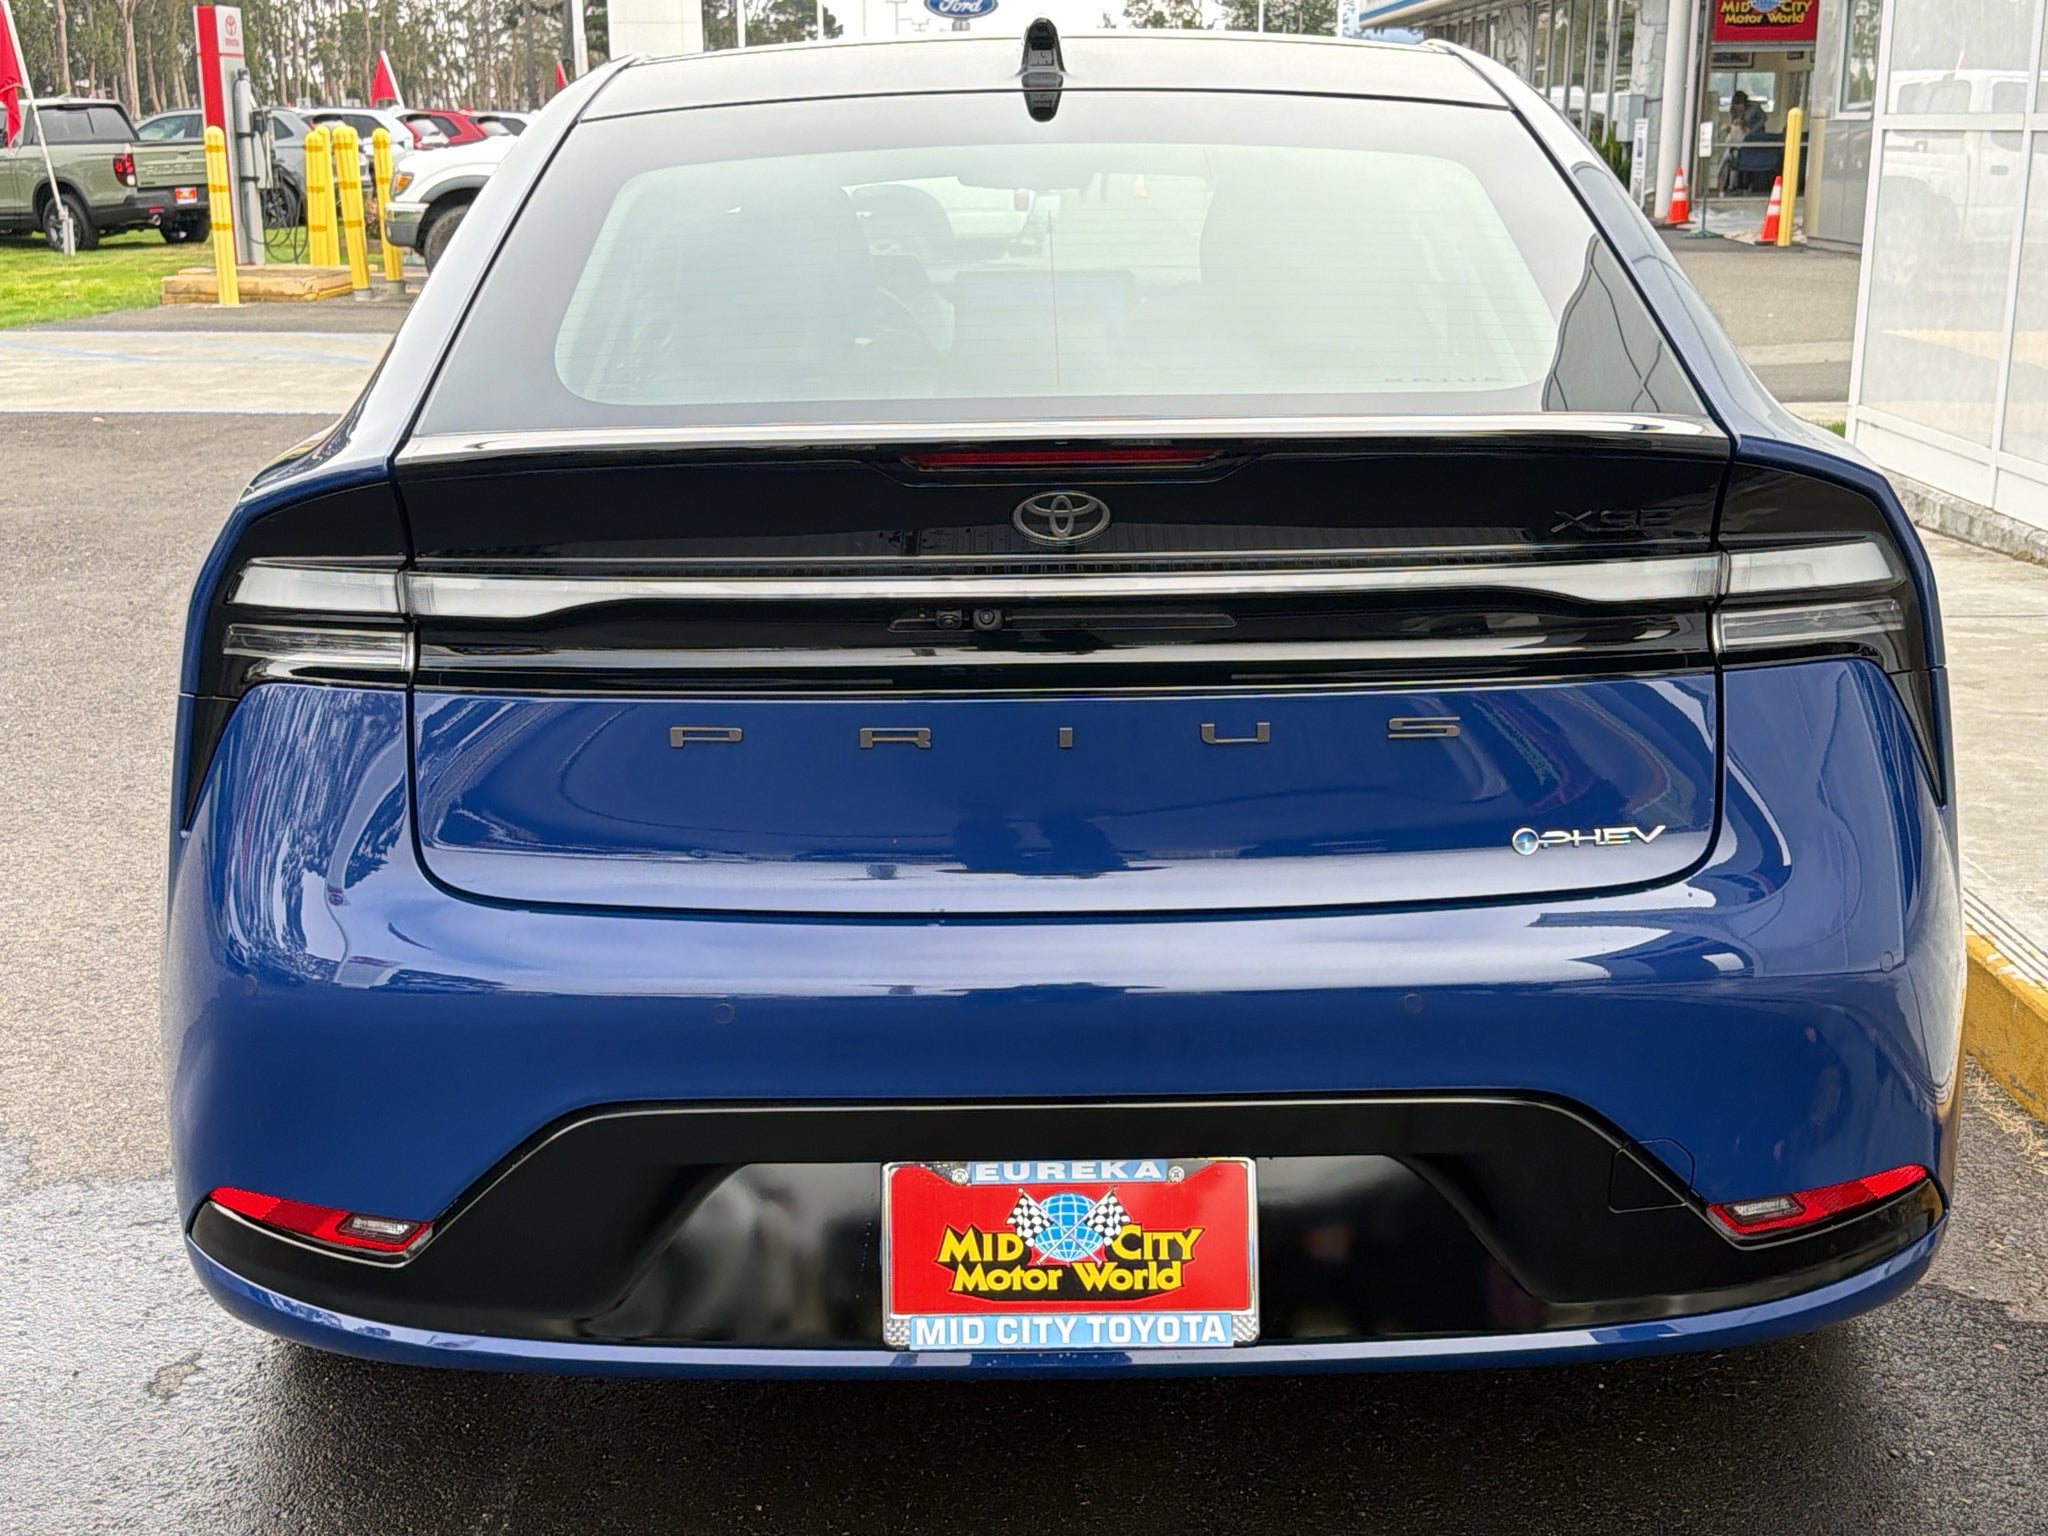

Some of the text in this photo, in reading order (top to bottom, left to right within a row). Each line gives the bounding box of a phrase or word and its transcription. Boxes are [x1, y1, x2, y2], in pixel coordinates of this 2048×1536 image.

[939, 0, 984, 12] Ford
[1724, 12, 1805, 24] Motor World
[1551, 509, 1676, 532] XSE
[669, 716, 1461, 749] PRIUS
[975, 1161, 1162, 1182] EUREKA
[938, 1224, 1204, 1263] MID CITY
[952, 1262, 1184, 1292] Motor World
[915, 1315, 1227, 1346] MID CITY TOYOTA
